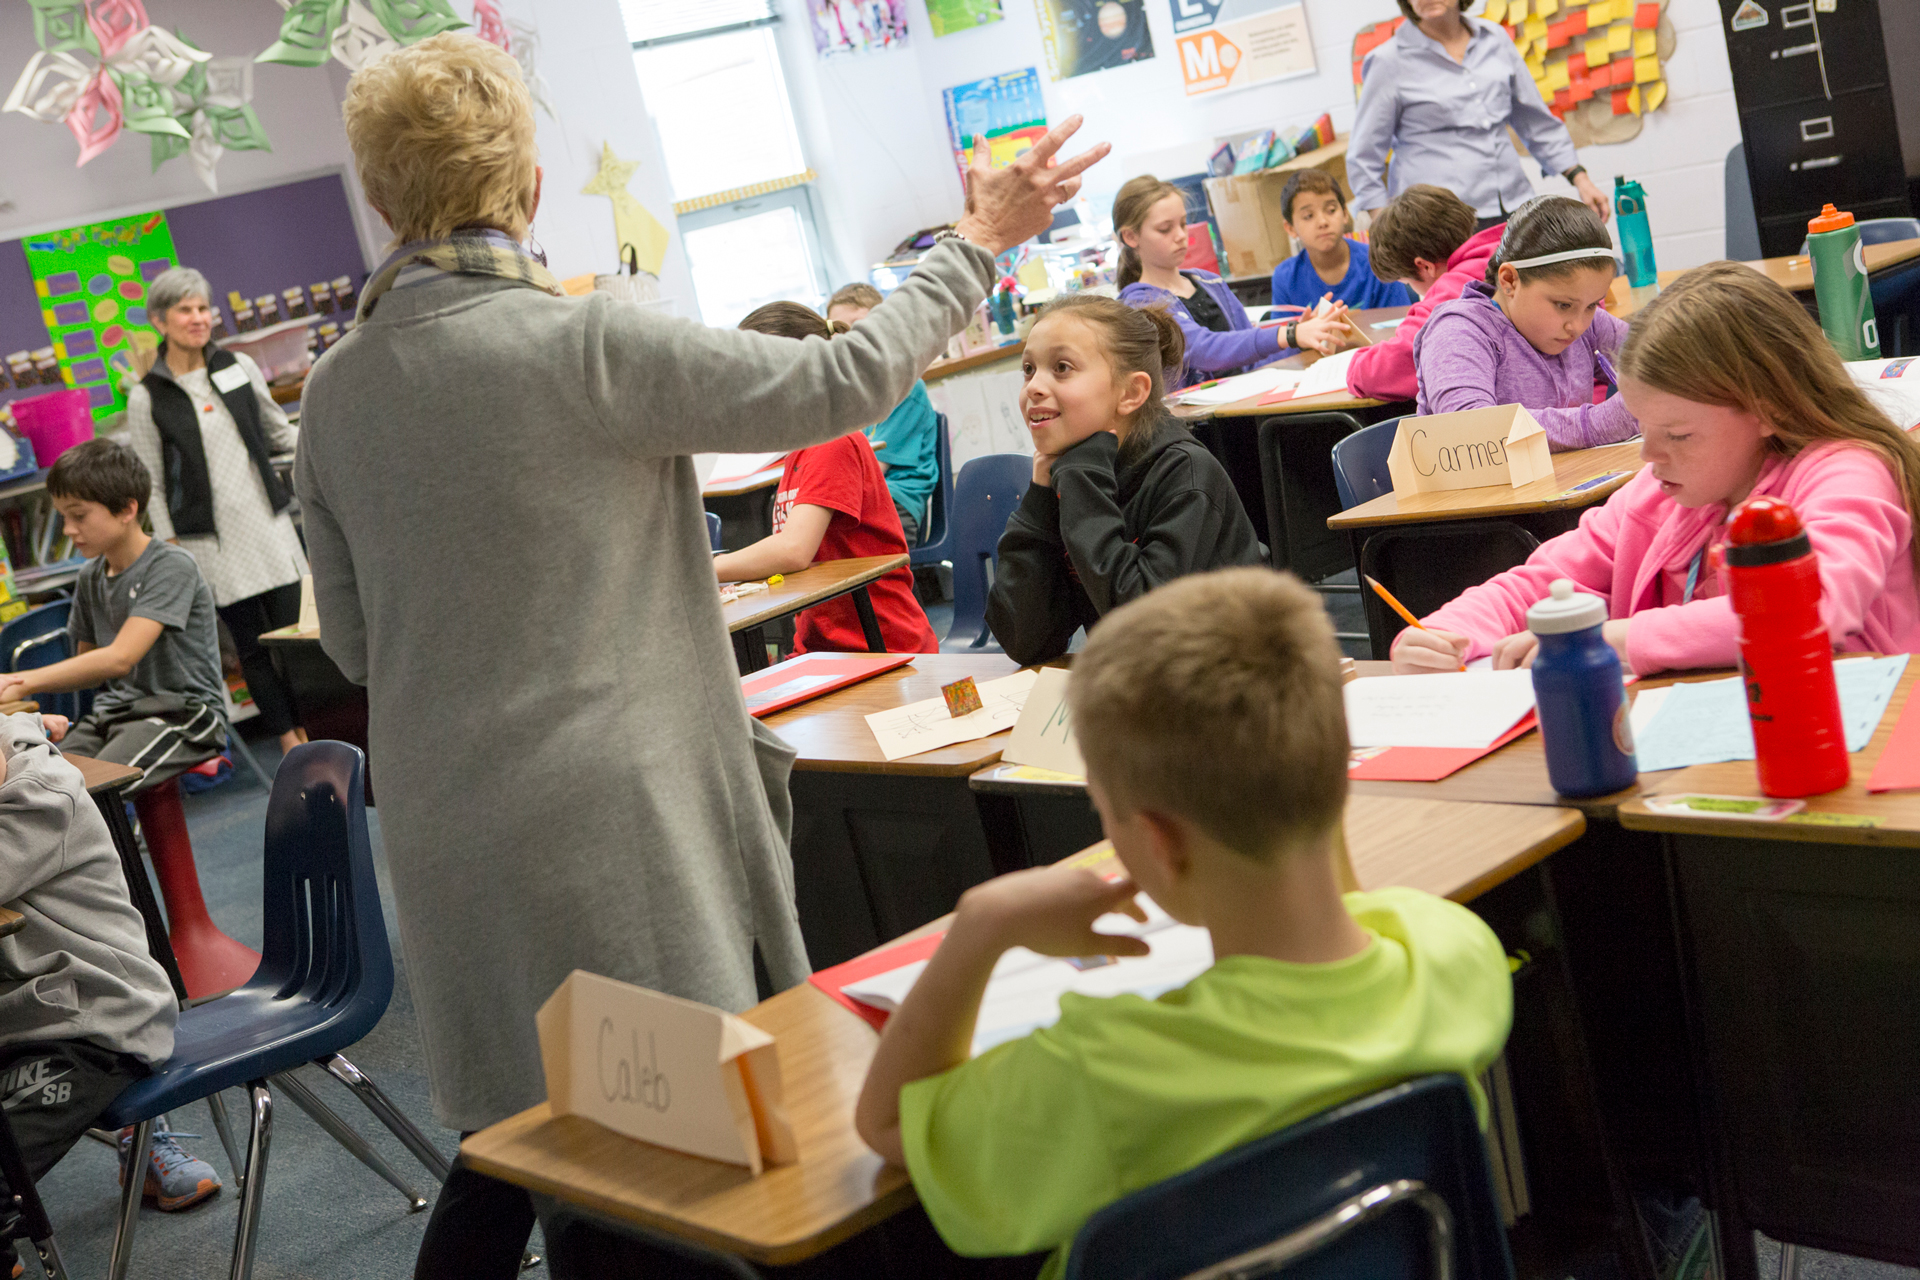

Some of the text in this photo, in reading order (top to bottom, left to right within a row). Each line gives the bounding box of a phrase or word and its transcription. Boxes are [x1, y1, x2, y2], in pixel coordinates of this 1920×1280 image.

[1181, 35, 1221, 81] M
[596, 1016, 671, 1113] Caleb
[41, 1081, 72, 1105] SB
